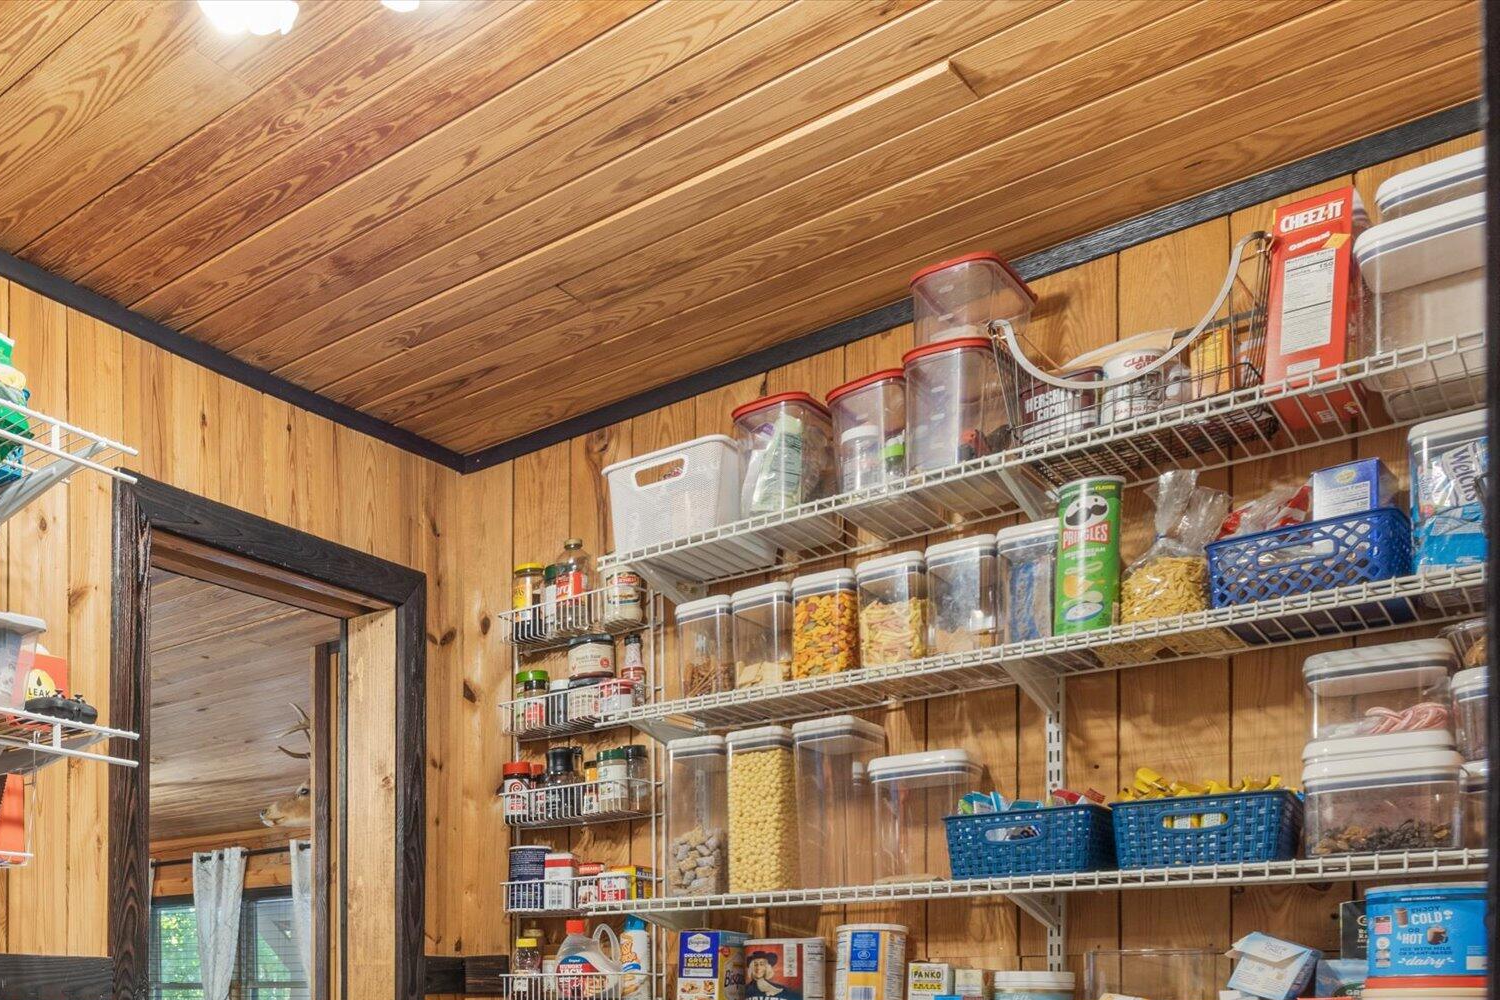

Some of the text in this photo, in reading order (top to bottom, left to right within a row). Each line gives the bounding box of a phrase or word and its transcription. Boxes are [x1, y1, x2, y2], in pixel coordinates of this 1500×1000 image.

[1280, 199, 1345, 233] CHEEZ-IT
[1062, 523, 1109, 549] PRINGLES
[1411, 912, 1443, 925] COLD
[1402, 933, 1423, 945] HOT
[913, 970, 942, 979] PANKO
